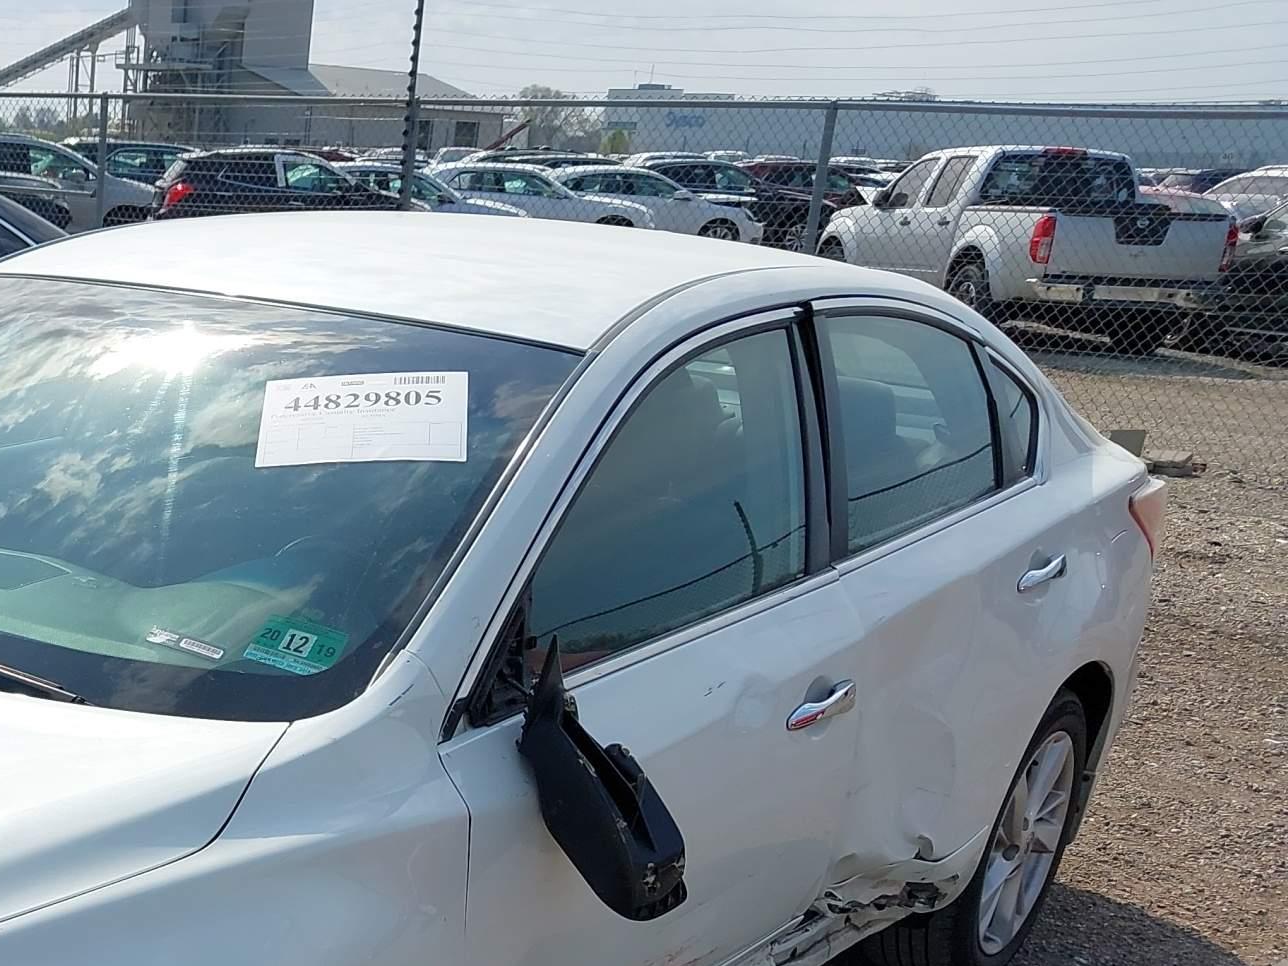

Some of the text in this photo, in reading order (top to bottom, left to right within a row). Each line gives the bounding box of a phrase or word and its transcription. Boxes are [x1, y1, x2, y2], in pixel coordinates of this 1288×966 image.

[283, 389, 444, 412] 44829805
[260, 627, 336, 658] 20 12 19
